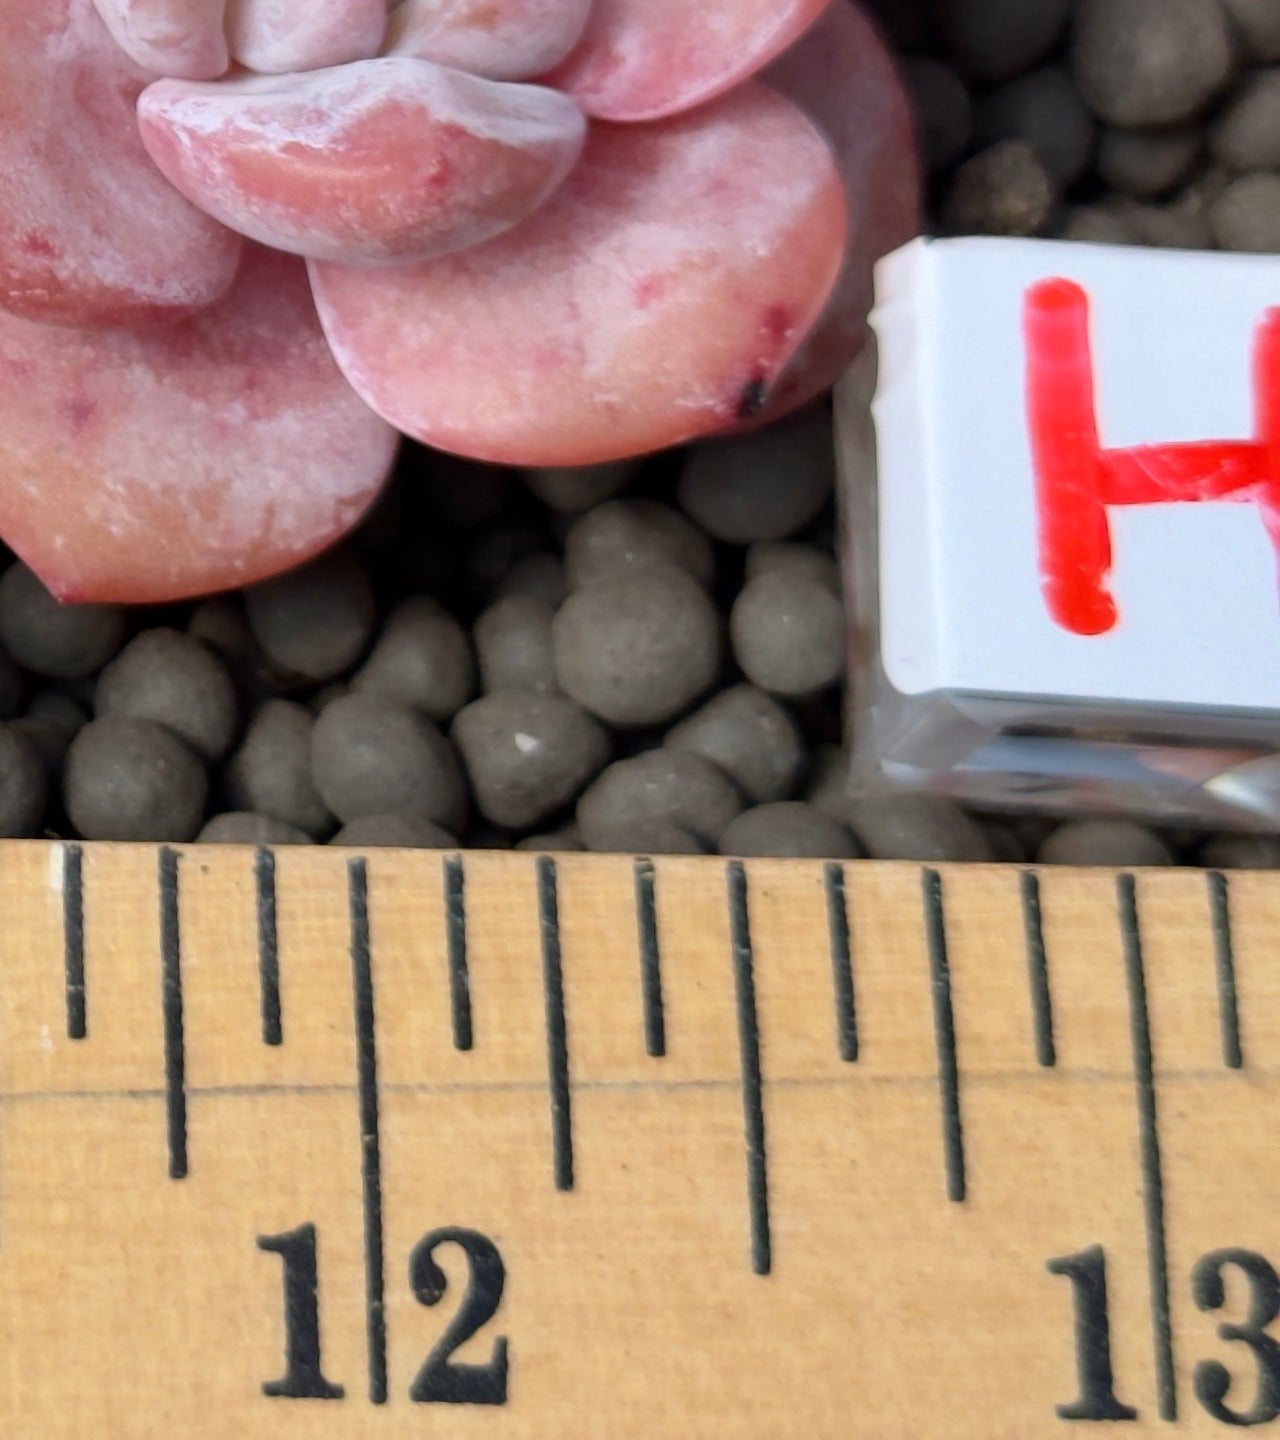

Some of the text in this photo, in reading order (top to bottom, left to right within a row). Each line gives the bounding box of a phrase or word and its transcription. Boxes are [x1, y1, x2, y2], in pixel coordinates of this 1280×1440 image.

[1023, 276, 1280, 636] H
[256, 1221, 512, 1407] 12
[1046, 1244, 1280, 1428] 13
